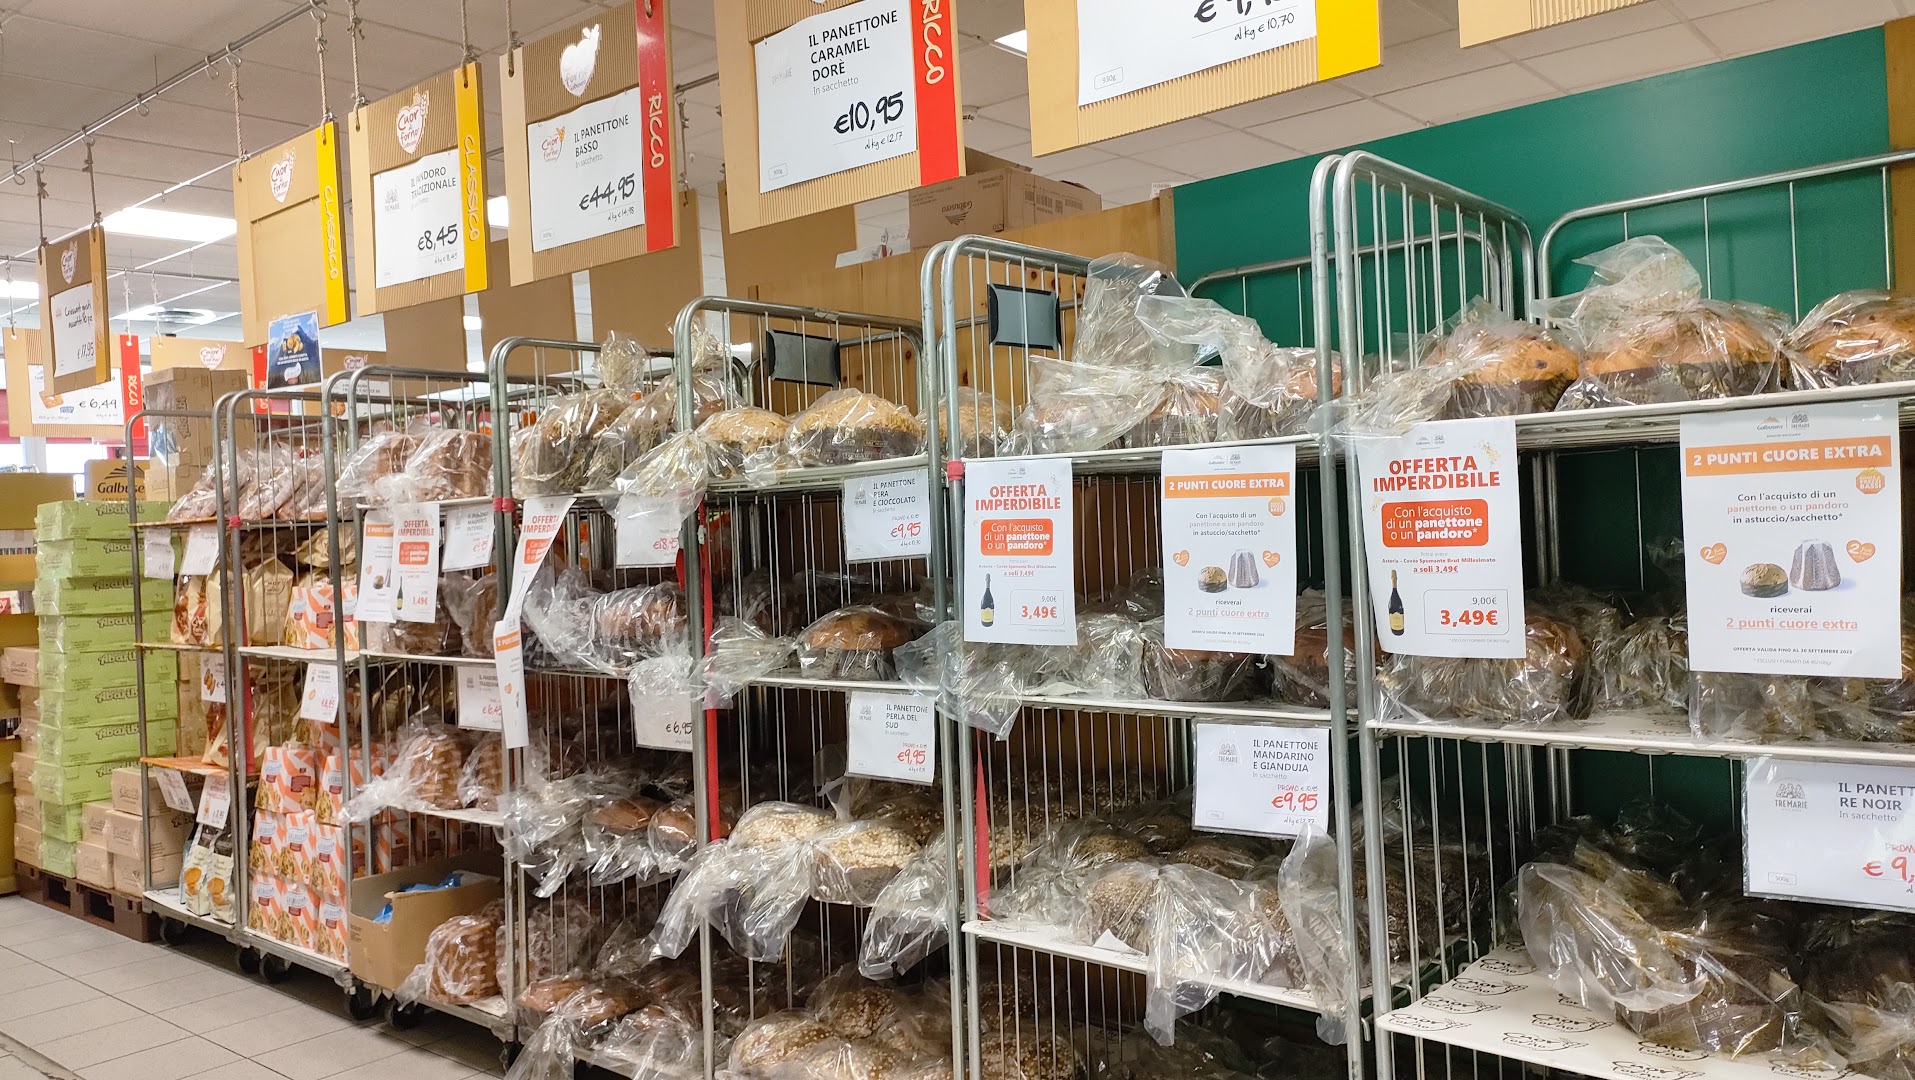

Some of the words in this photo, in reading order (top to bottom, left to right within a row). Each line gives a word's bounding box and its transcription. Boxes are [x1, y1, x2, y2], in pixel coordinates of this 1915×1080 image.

[808, 34, 819, 48] IL
[822, 10, 898, 43] PANETTONE
[810, 37, 870, 64] CARAMEL
[812, 59, 846, 82] DORÈ
[822, 76, 859, 93] sacchetto
[833, 91, 904, 134] €10,95
[397, 108, 419, 131] Cuor
[574, 132, 580, 144] IL
[580, 114, 630, 142] PANETTONE
[648, 92, 666, 169] RICCO
[399, 128, 420, 144] forno
[575, 139, 599, 159] BASSO
[464, 134, 480, 242] CLASSICO
[324, 185, 339, 281] CLASSICO
[417, 222, 459, 251] €8,45
[128, 375, 138, 405] RICCO
[1693, 454, 1702, 466] 2
[1707, 452, 1758, 466] PUNTI
[1762, 447, 1819, 462] CUORE
[1824, 444, 1883, 459] EXTRA
[1389, 456, 1477, 475] OFFERTA
[873, 482, 879, 490] IL
[880, 478, 916, 489] PANETTONE
[1169, 481, 1175, 491] 2
[1177, 480, 1209, 491] PUNTI
[1211, 479, 1247, 490] CUORE
[1249, 478, 1285, 489] EXTRA
[1373, 471, 1500, 492] IMPERDIBILE
[873, 490, 889, 498] PERA
[989, 485, 1047, 498] OFFERTA
[1737, 493, 1757, 502] Con
[1759, 491, 1808, 501] l'acquisto
[1810, 490, 1820, 498] di
[877, 495, 916, 506] CIOCCOLATO
[975, 497, 1061, 511] IMPERDIBILE
[1394, 507, 1415, 518] Con
[1418, 505, 1472, 519] l'acquisto
[1727, 503, 1777, 514] panettone
[1805, 501, 1849, 512] pandoro
[1209, 512, 1239, 520] l'acquisto
[1732, 515, 1742, 523] in
[403, 520, 429, 528] OFFERTA
[890, 521, 922, 539] €9,95
[991, 523, 1007, 532] Con
[1009, 522, 1044, 533] l'acquisto
[1189, 520, 1221, 528] panettone
[1237, 519, 1265, 528] pandoro
[1386, 518, 1396, 529] di
[1399, 519, 1412, 529] un
[1415, 517, 1483, 531] panettone
[398, 528, 435, 536] IMPERDIBILE
[984, 532, 992, 541] di
[994, 533, 1005, 541] un
[1006, 532, 1051, 542] panettone
[1390, 531, 1398, 540] o
[1400, 530, 1414, 540] un
[987, 542, 993, 550] o
[995, 542, 1006, 550] un
[1848, 543, 1860, 555] 2
[1704, 549, 1713, 559] 2
[1420, 565, 1434, 573] soli
[1435, 565, 1459, 574] 3,49€
[1215, 598, 1242, 606] riceverai
[1472, 596, 1498, 606] 9,00€
[1021, 605, 1058, 620] 3,49€
[1188, 607, 1194, 616] 2
[1195, 607, 1218, 618] punti
[1220, 609, 1245, 617] cuore
[1246, 610, 1270, 618] extra
[1770, 605, 1812, 613] riceverai
[1440, 609, 1498, 628] 3,49€
[1726, 618, 1734, 627] 2
[1738, 617, 1775, 630] punti
[1779, 618, 1818, 629] cuore
[1822, 619, 1858, 630] extra
[886, 703, 892, 711] IL
[893, 704, 929, 714] PANETTONE
[885, 712, 905, 721] PERLA
[906, 714, 918, 722] DEL
[885, 721, 899, 729] SUD
[1253, 739, 1261, 748] IL
[1263, 739, 1319, 750] PANETTONE
[897, 748, 926, 765] €9,95
[1253, 750, 1314, 761] MANDARINO
[1253, 761, 1258, 770] E
[1260, 762, 1309, 773] GIANDUIA
[1259, 772, 1288, 780] sacchetto
[1838, 782, 1851, 794] IL
[1271, 791, 1319, 813] €9,95
[1840, 797, 1858, 808] RE
[1862, 798, 1903, 811] NOIR
[1839, 810, 1849, 819] In
[1852, 812, 1898, 822] sacchetto
